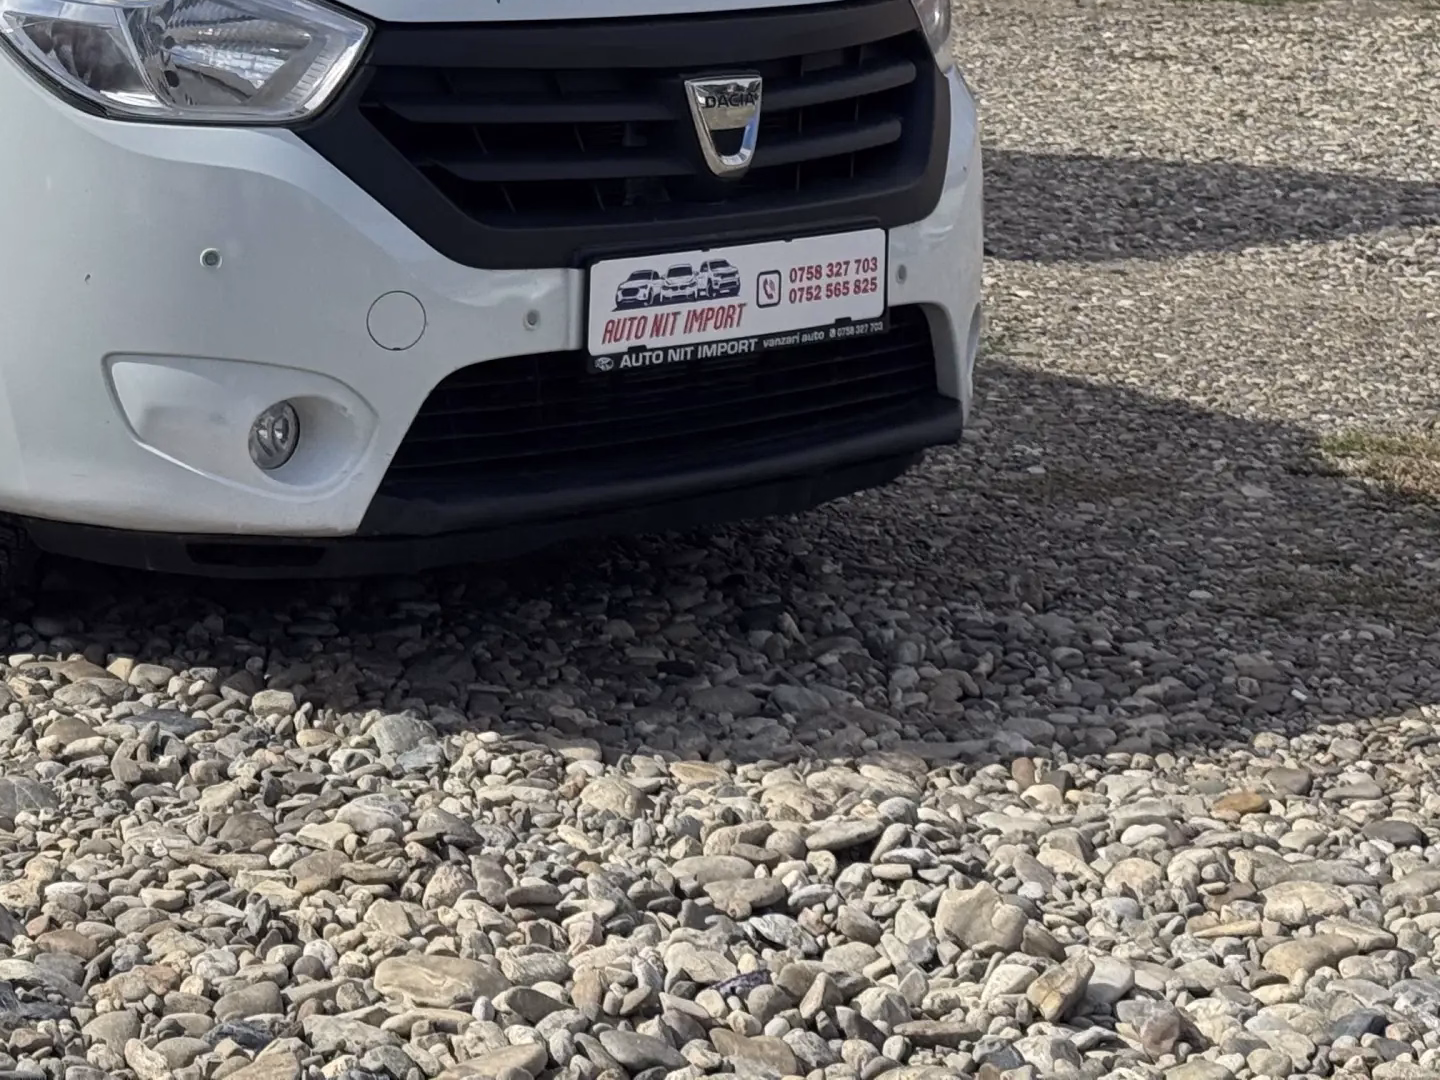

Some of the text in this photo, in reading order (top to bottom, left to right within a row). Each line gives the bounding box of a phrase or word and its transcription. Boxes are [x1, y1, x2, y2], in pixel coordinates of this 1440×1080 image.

[704, 92, 756, 109] DACIA
[789, 256, 878, 284] 0758 327 703
[788, 277, 878, 304] 0752 565 825
[601, 303, 747, 345] AUTO NIT IMPORT
[619, 350, 663, 369] AUTO
[667, 347, 695, 363] NIT
[697, 338, 759, 359] IMPORT
[802, 330, 825, 344] auto
